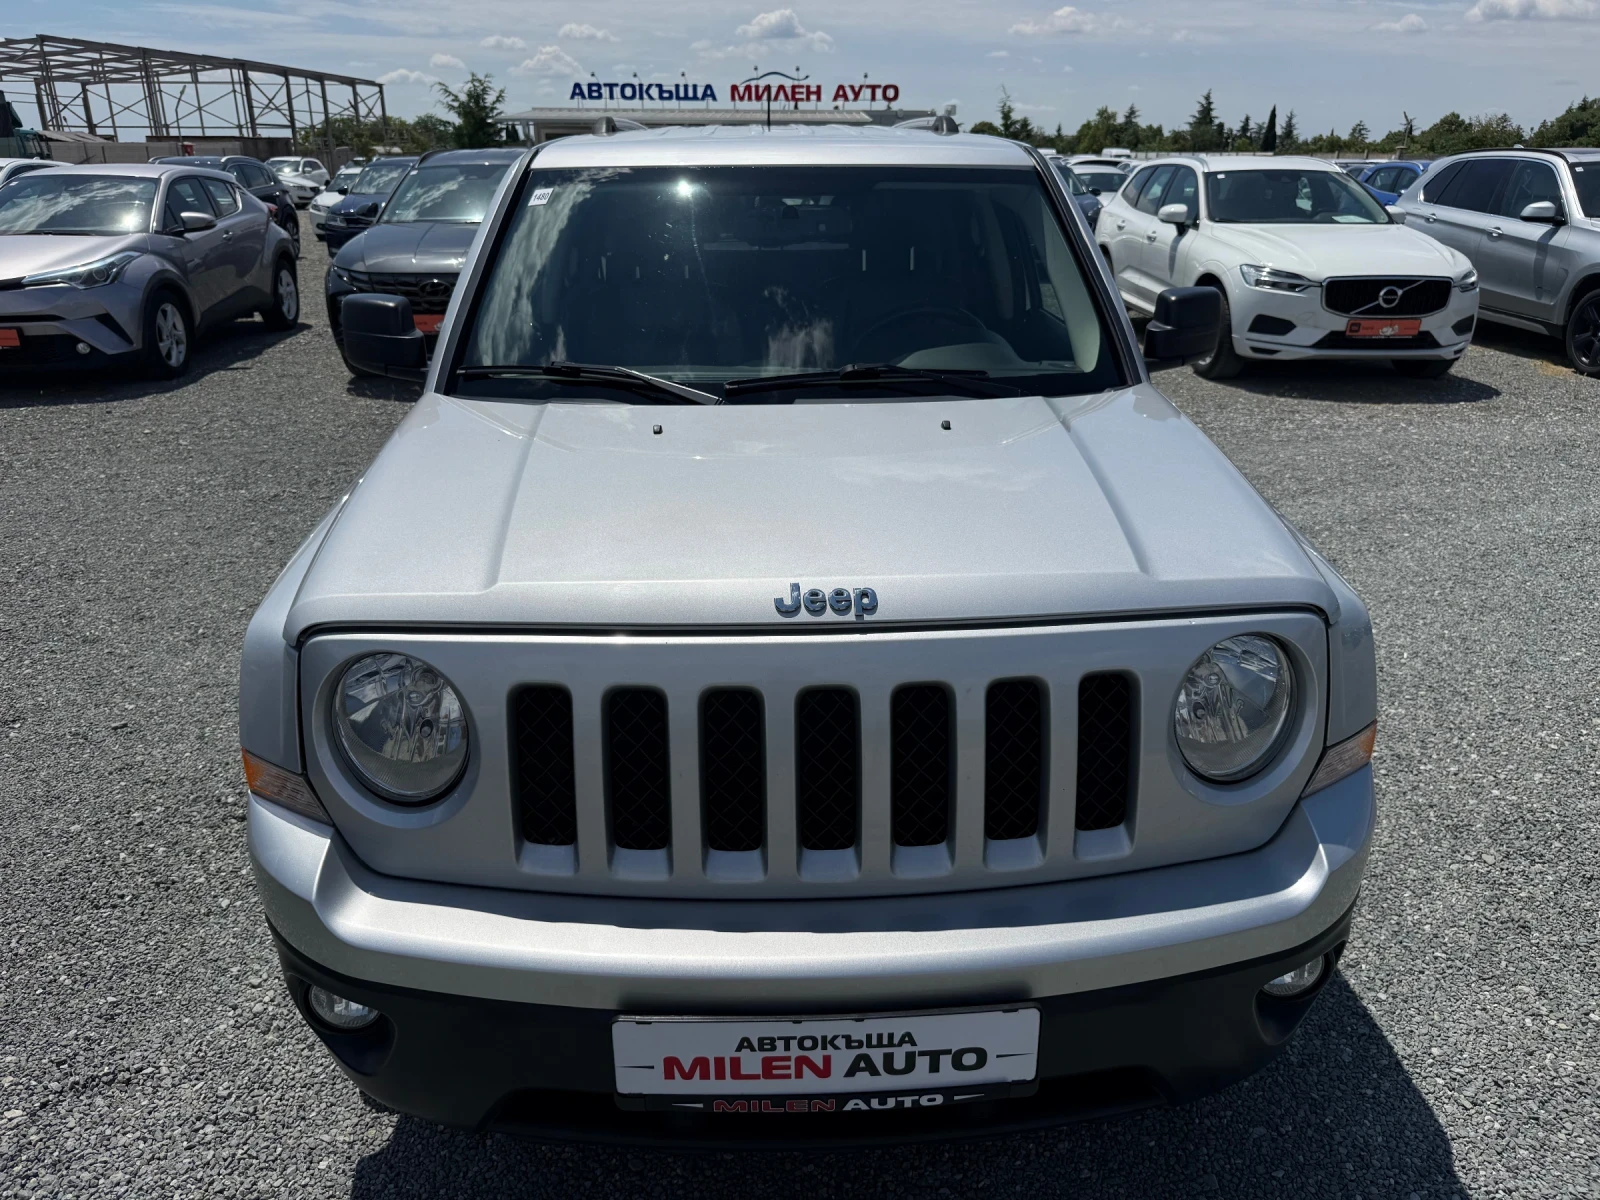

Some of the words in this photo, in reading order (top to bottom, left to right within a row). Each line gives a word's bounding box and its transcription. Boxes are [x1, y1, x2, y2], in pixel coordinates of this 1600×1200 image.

[730, 84, 822, 102] МИЛЕН
[832, 84, 900, 102] АУТО
[533, 192, 550, 201] 1480
[774, 582, 878, 618] Jeep
[663, 1055, 832, 1081] MILEN
[843, 1047, 988, 1078] AUTO
[713, 1099, 836, 1113] MILEN
[842, 1093, 943, 1112] AUTO
